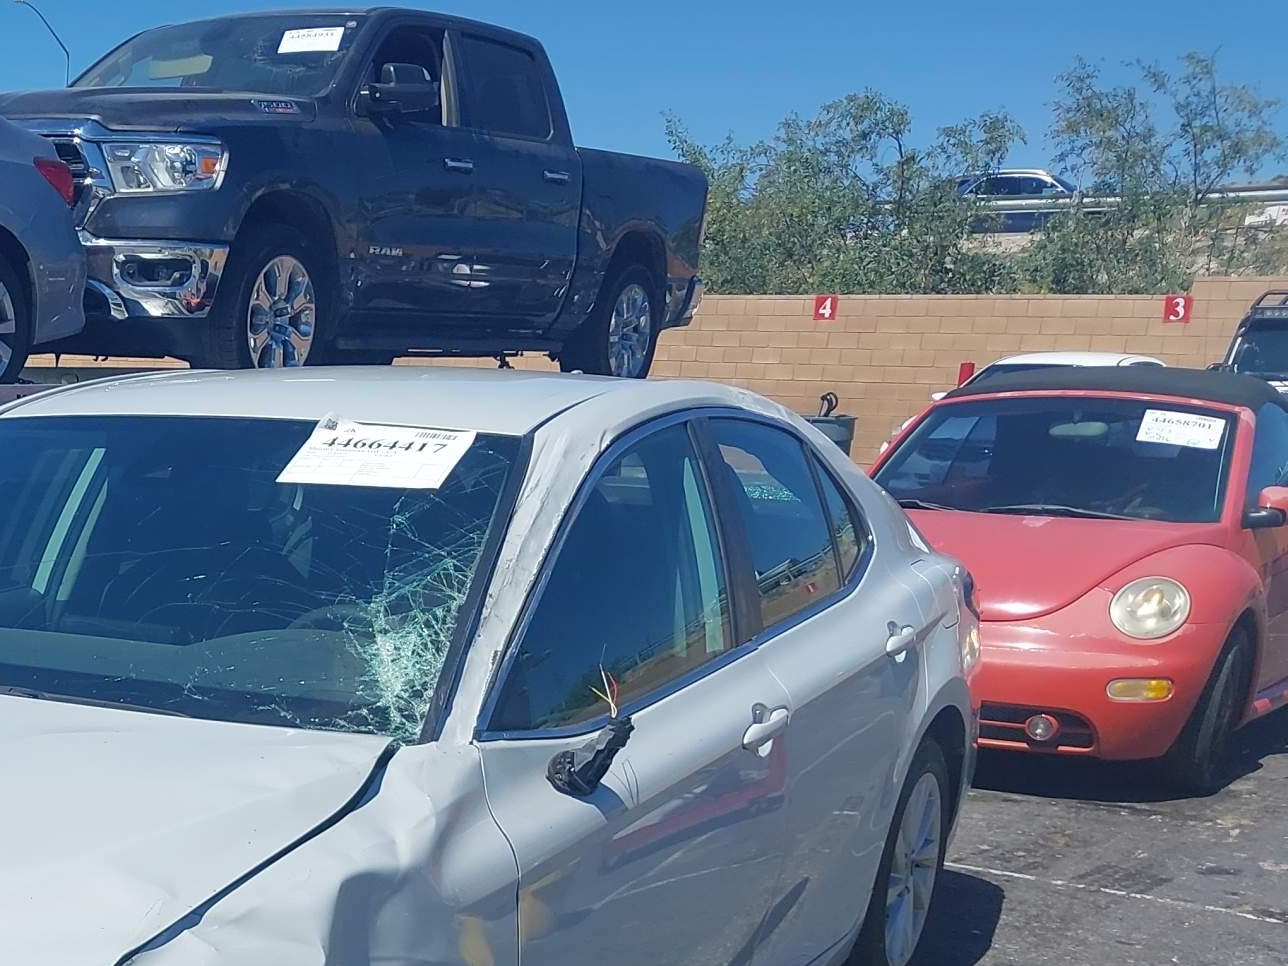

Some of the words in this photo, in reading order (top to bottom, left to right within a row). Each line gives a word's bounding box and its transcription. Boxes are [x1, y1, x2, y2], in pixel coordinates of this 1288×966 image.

[368, 246, 403, 257] RAM
[818, 296, 832, 318] 4
[1168, 297, 1185, 320] 3
[321, 435, 449, 454] 44664417
